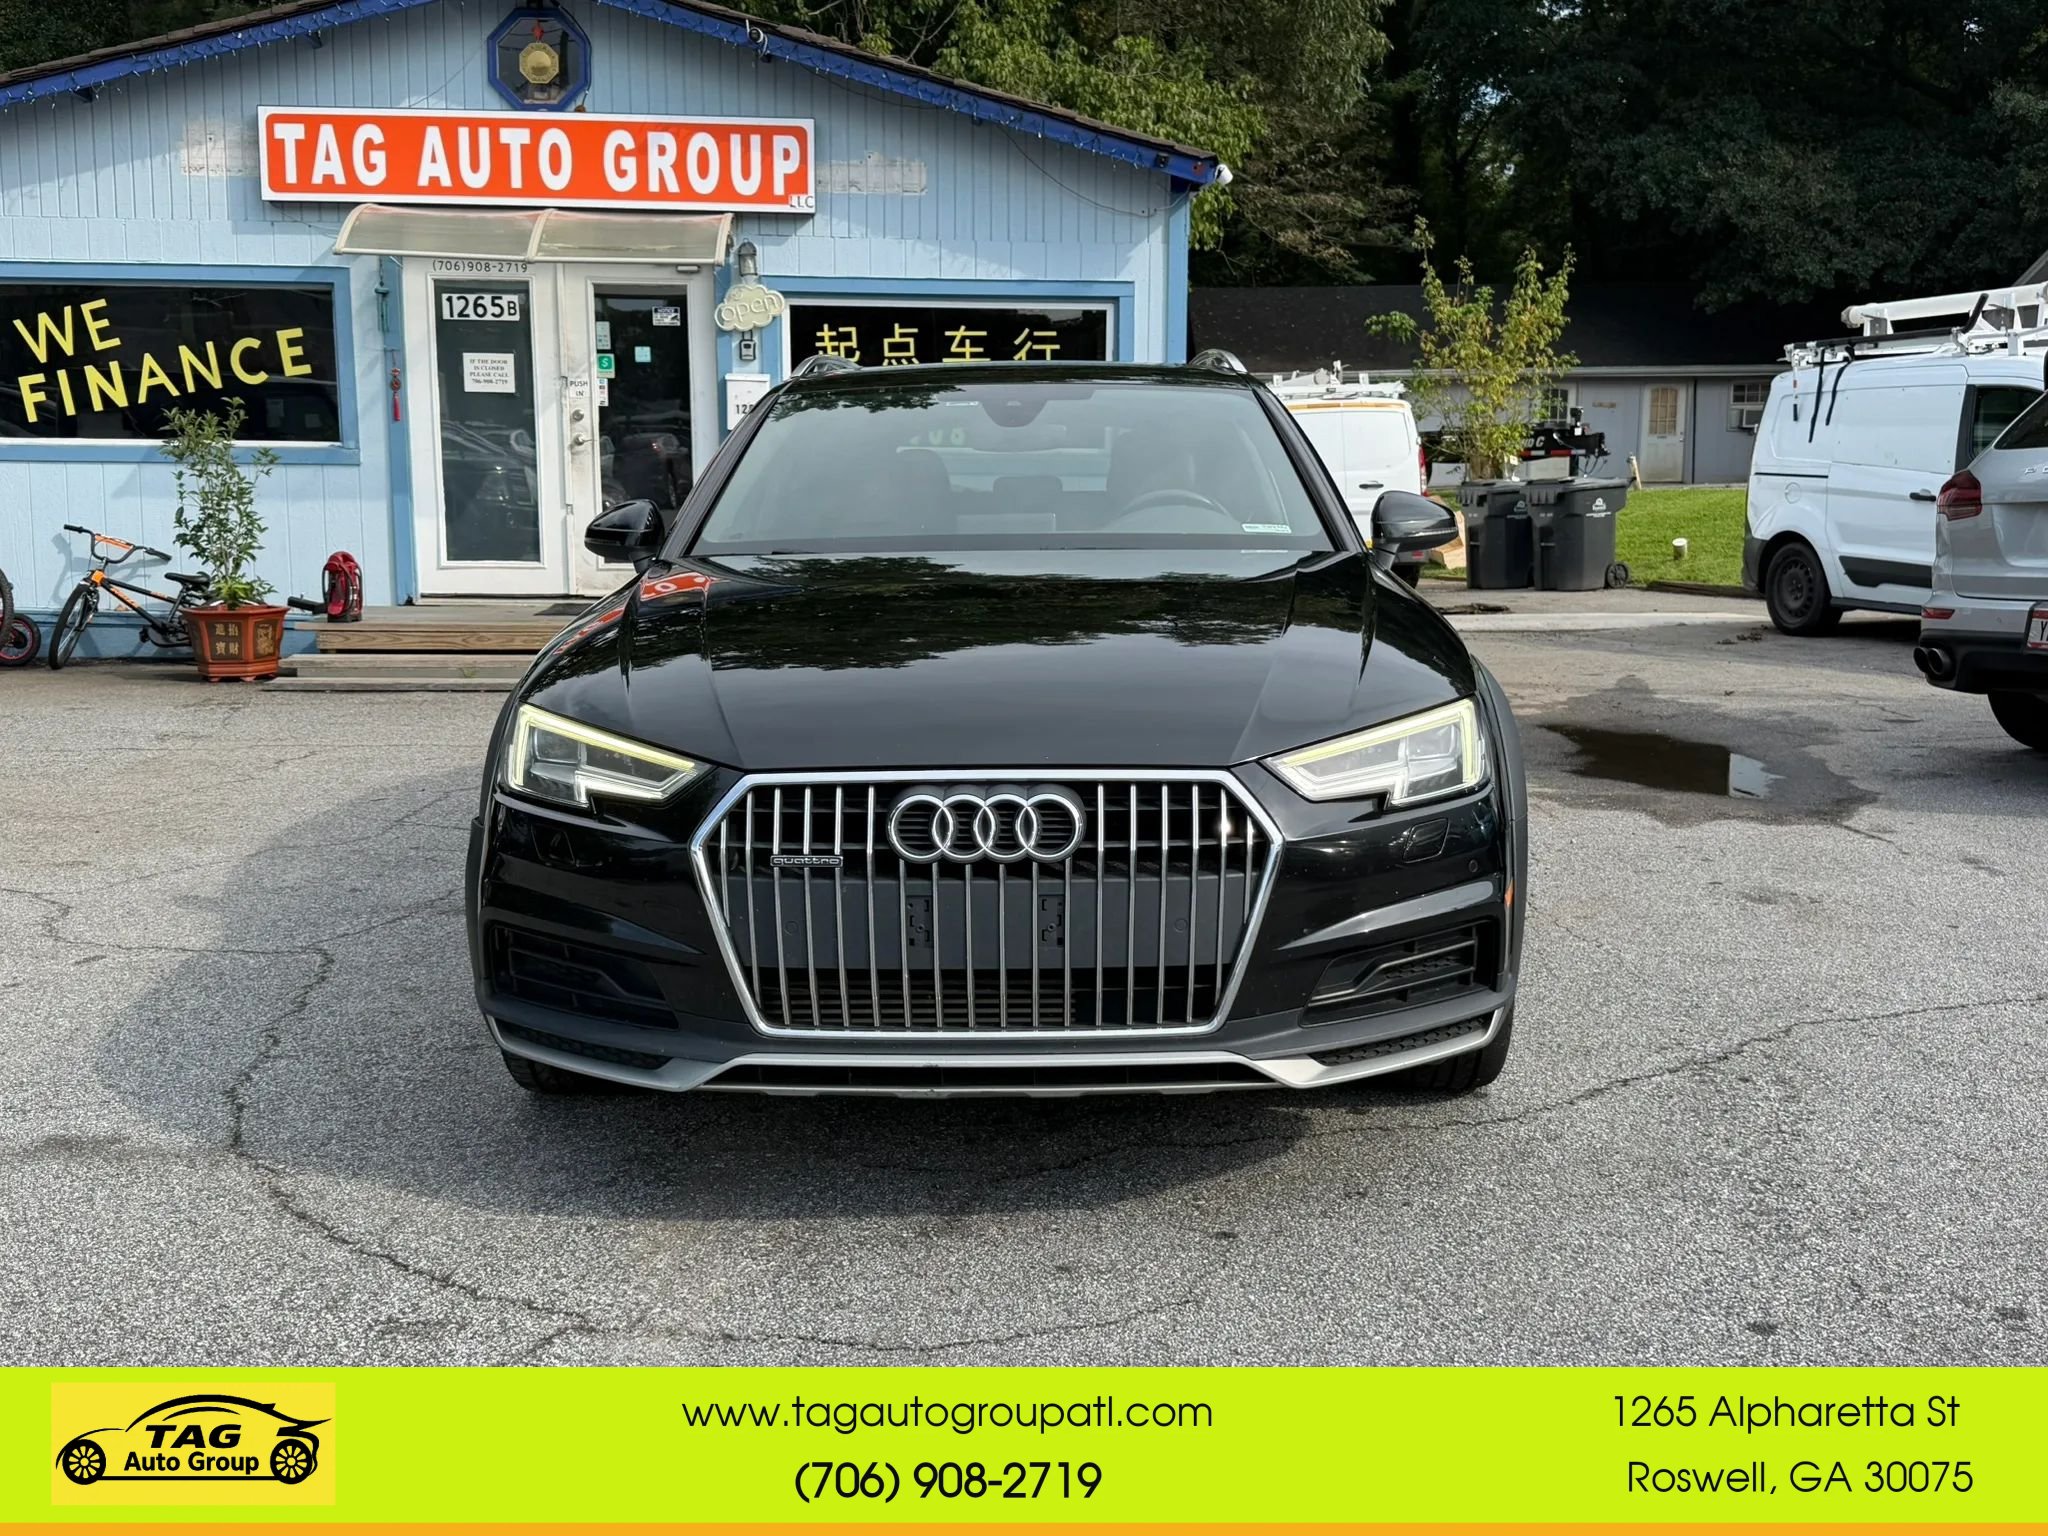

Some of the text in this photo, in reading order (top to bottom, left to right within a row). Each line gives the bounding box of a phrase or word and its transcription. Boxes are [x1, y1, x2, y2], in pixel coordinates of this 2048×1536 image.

[273, 122, 801, 196] TAG AUTO GROUP
[790, 195, 814, 208] LLC
[432, 259, 528, 273] (706)908-2719
[721, 295, 779, 323] open
[13, 298, 122, 363] WE
[815, 323, 1060, 366] 起点车行
[17, 327, 312, 423] FINANCE
[773, 857, 840, 865] quattro
